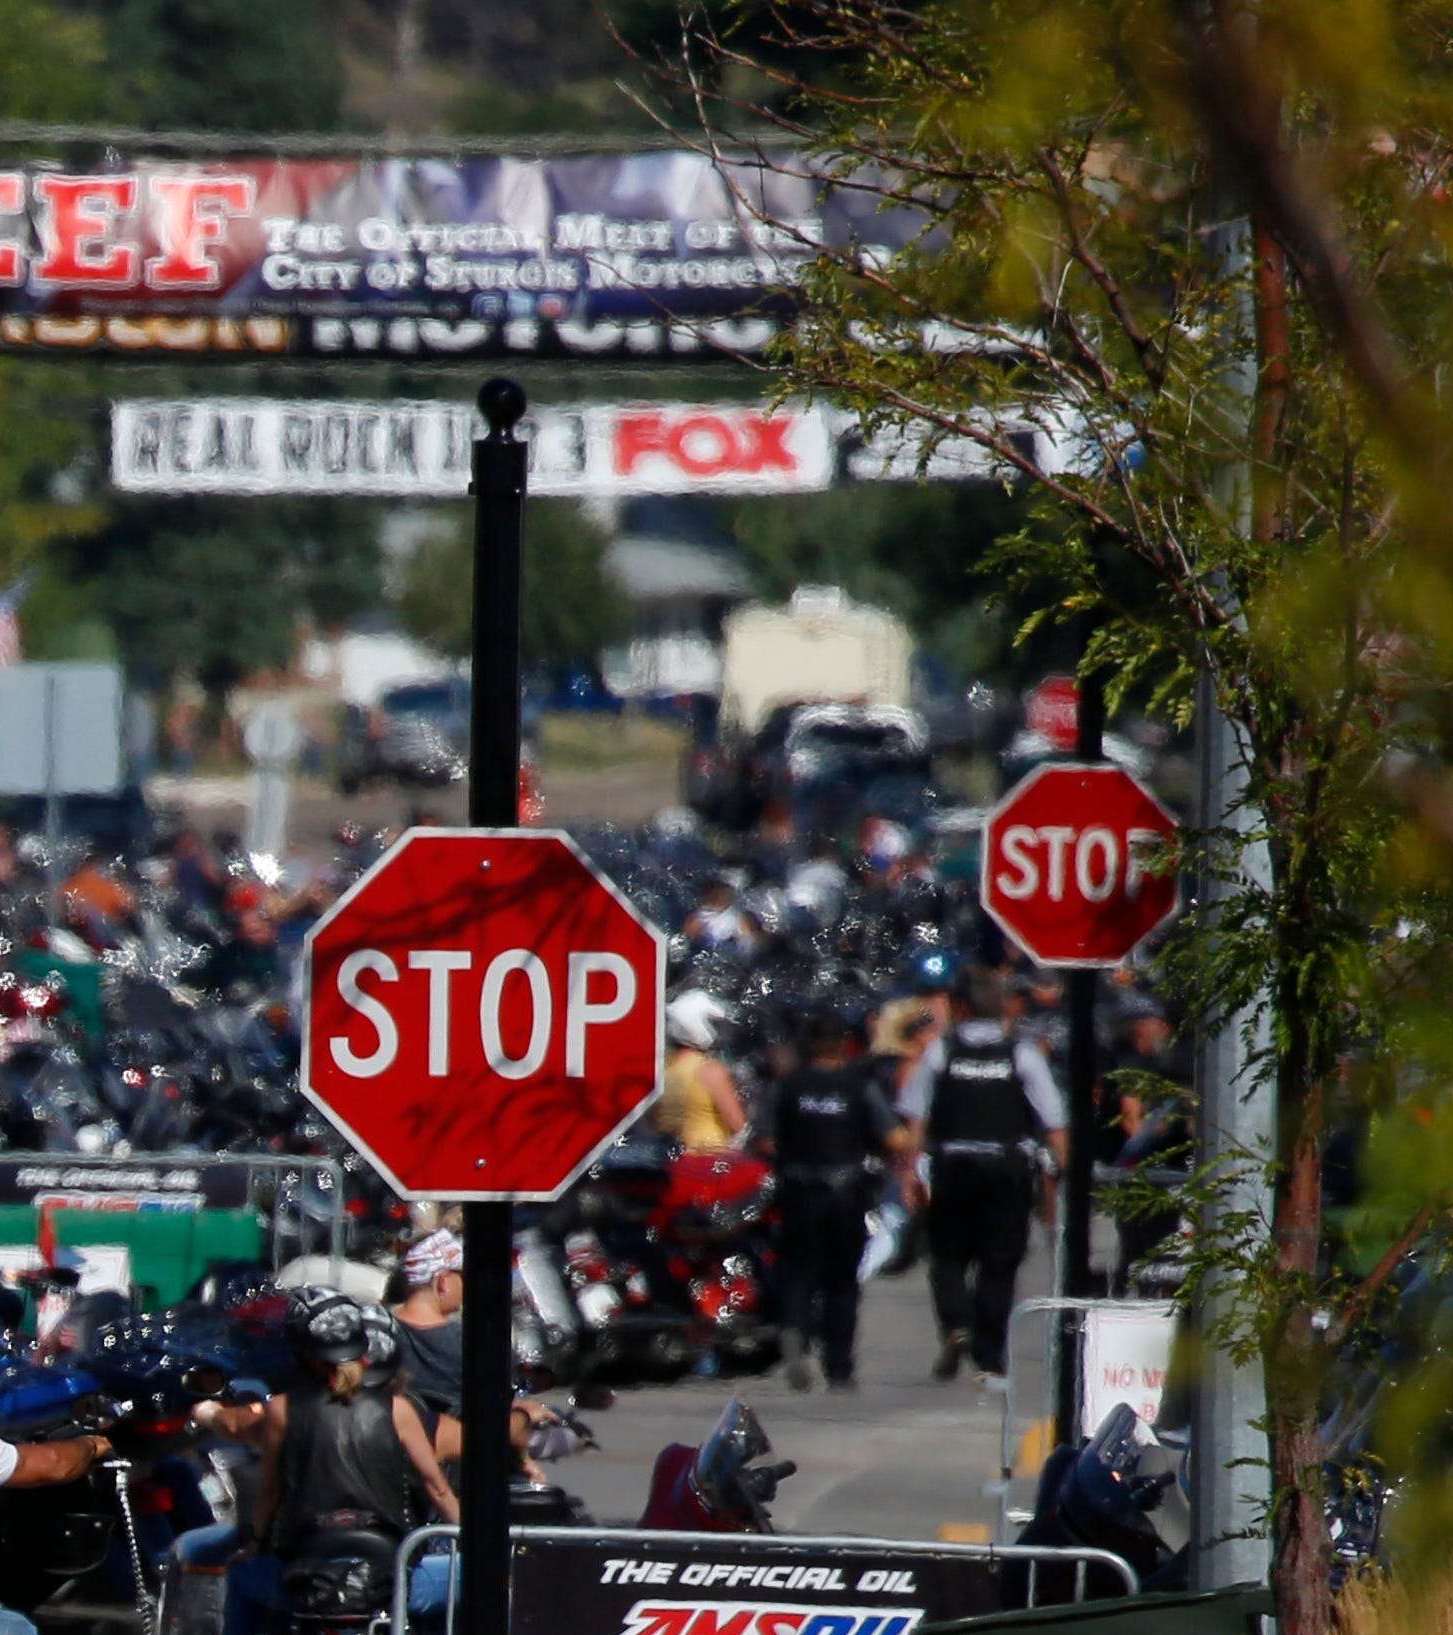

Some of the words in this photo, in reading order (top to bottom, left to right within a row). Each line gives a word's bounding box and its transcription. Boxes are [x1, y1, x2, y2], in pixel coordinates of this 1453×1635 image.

[611, 415, 795, 475] FOX
[329, 948, 638, 1080] STOP
[599, 1558, 674, 1586] THE
[680, 1561, 845, 1592] OFFICIAL
[856, 1567, 918, 1595] OIL
